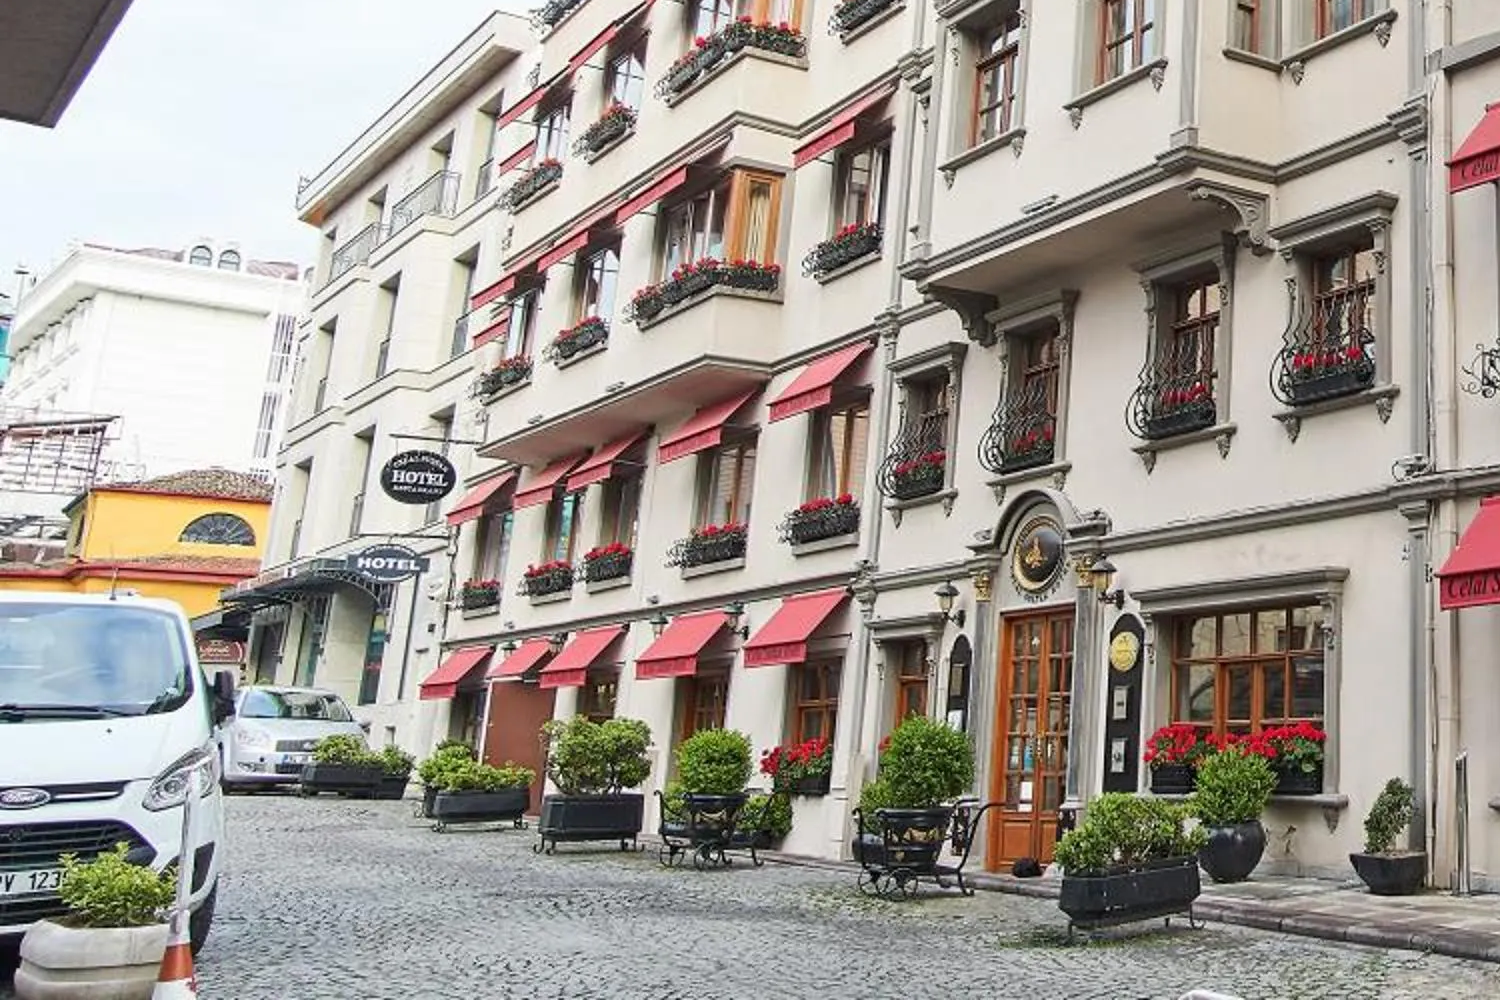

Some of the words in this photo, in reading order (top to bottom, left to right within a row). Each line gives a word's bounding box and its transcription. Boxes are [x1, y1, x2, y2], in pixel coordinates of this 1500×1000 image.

[1461, 153, 1498, 180] Celal
[391, 470, 448, 486] HOTEL
[357, 557, 420, 570] HOTEL
[1448, 576, 1487, 598] Celal
[0, 874, 15, 893] V
